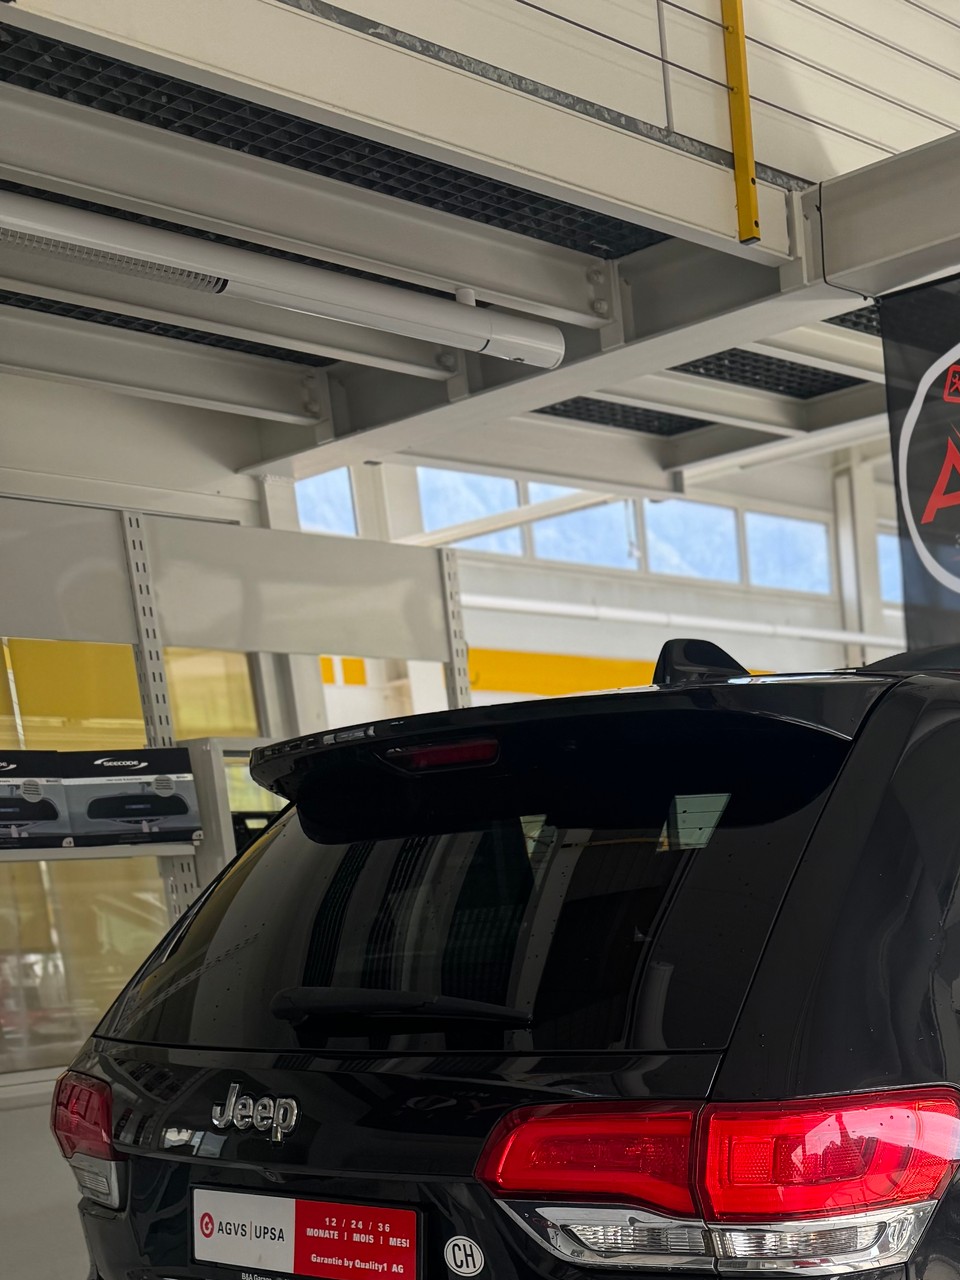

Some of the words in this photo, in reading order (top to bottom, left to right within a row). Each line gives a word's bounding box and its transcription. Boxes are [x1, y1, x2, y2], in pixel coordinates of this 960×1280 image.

[211, 1083, 298, 1142] Jeep
[217, 1221, 247, 1237] AGVS
[254, 1225, 285, 1242] UPSA
[325, 1217, 337, 1227] 12
[351, 1220, 363, 1229] 24
[378, 1223, 391, 1232] 36
[306, 1228, 339, 1239] MONATE
[353, 1233, 374, 1244] MOIS
[389, 1237, 410, 1248] MESI
[311, 1254, 343, 1266] Garantie
[344, 1258, 354, 1269] by
[354, 1259, 388, 1273] Quality1
[392, 1264, 404, 1274] AG
[452, 1243, 476, 1270] CH
